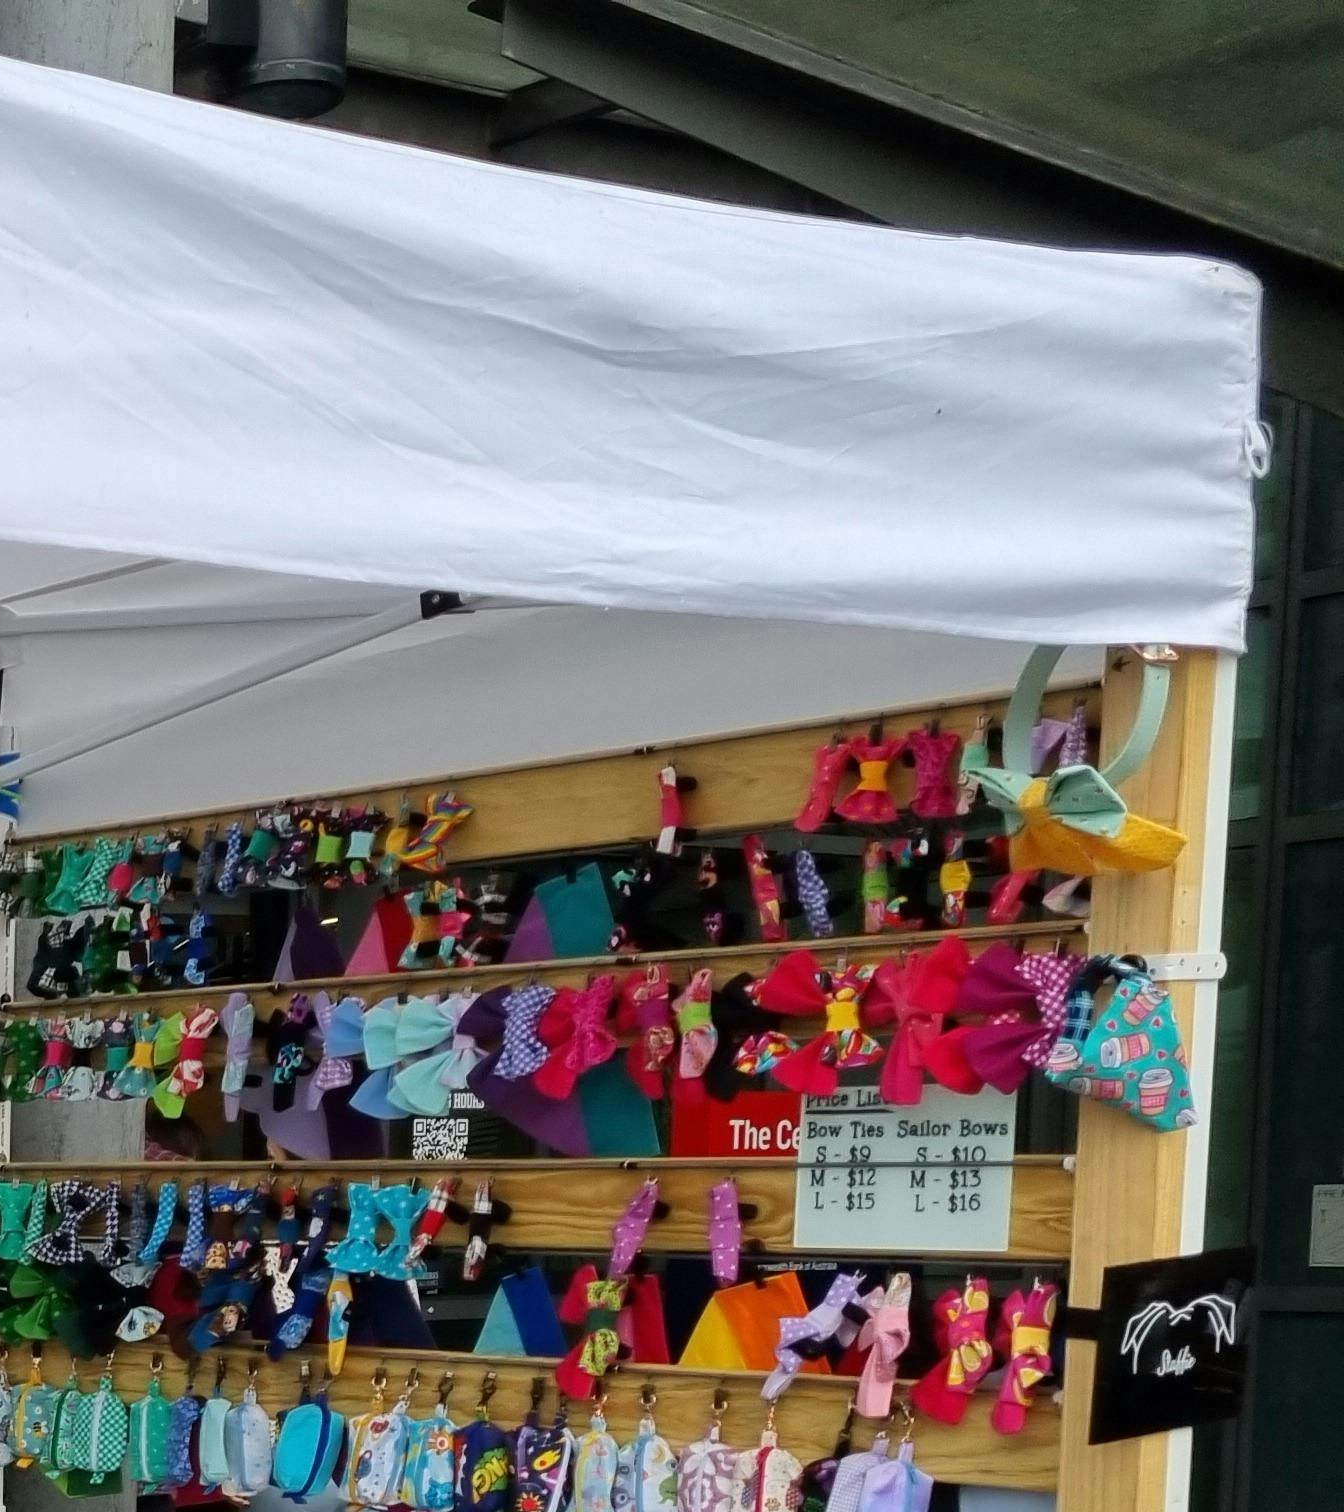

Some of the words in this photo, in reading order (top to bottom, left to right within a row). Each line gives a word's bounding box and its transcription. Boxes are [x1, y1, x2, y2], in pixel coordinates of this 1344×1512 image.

[857, 1089, 888, 1107] Lis
[729, 1118, 770, 1150] The
[776, 1118, 800, 1150] Ce
[807, 1121, 842, 1139] Bow
[850, 1120, 885, 1139] Ties
[897, 1119, 951, 1139] Sailor
[959, 1119, 1009, 1137] Bows
[815, 1146, 827, 1163] S
[849, 1145, 871, 1163] $9
[915, 1147, 927, 1163] S
[951, 1145, 986, 1163] $10
[811, 1170, 825, 1187] M
[847, 1168, 876, 1188] $12
[910, 1170, 926, 1188] M
[949, 1169, 981, 1190] $13
[814, 1192, 824, 1210] L
[845, 1192, 875, 1211] $15
[914, 1195, 925, 1212] L
[947, 1193, 981, 1213] $16
